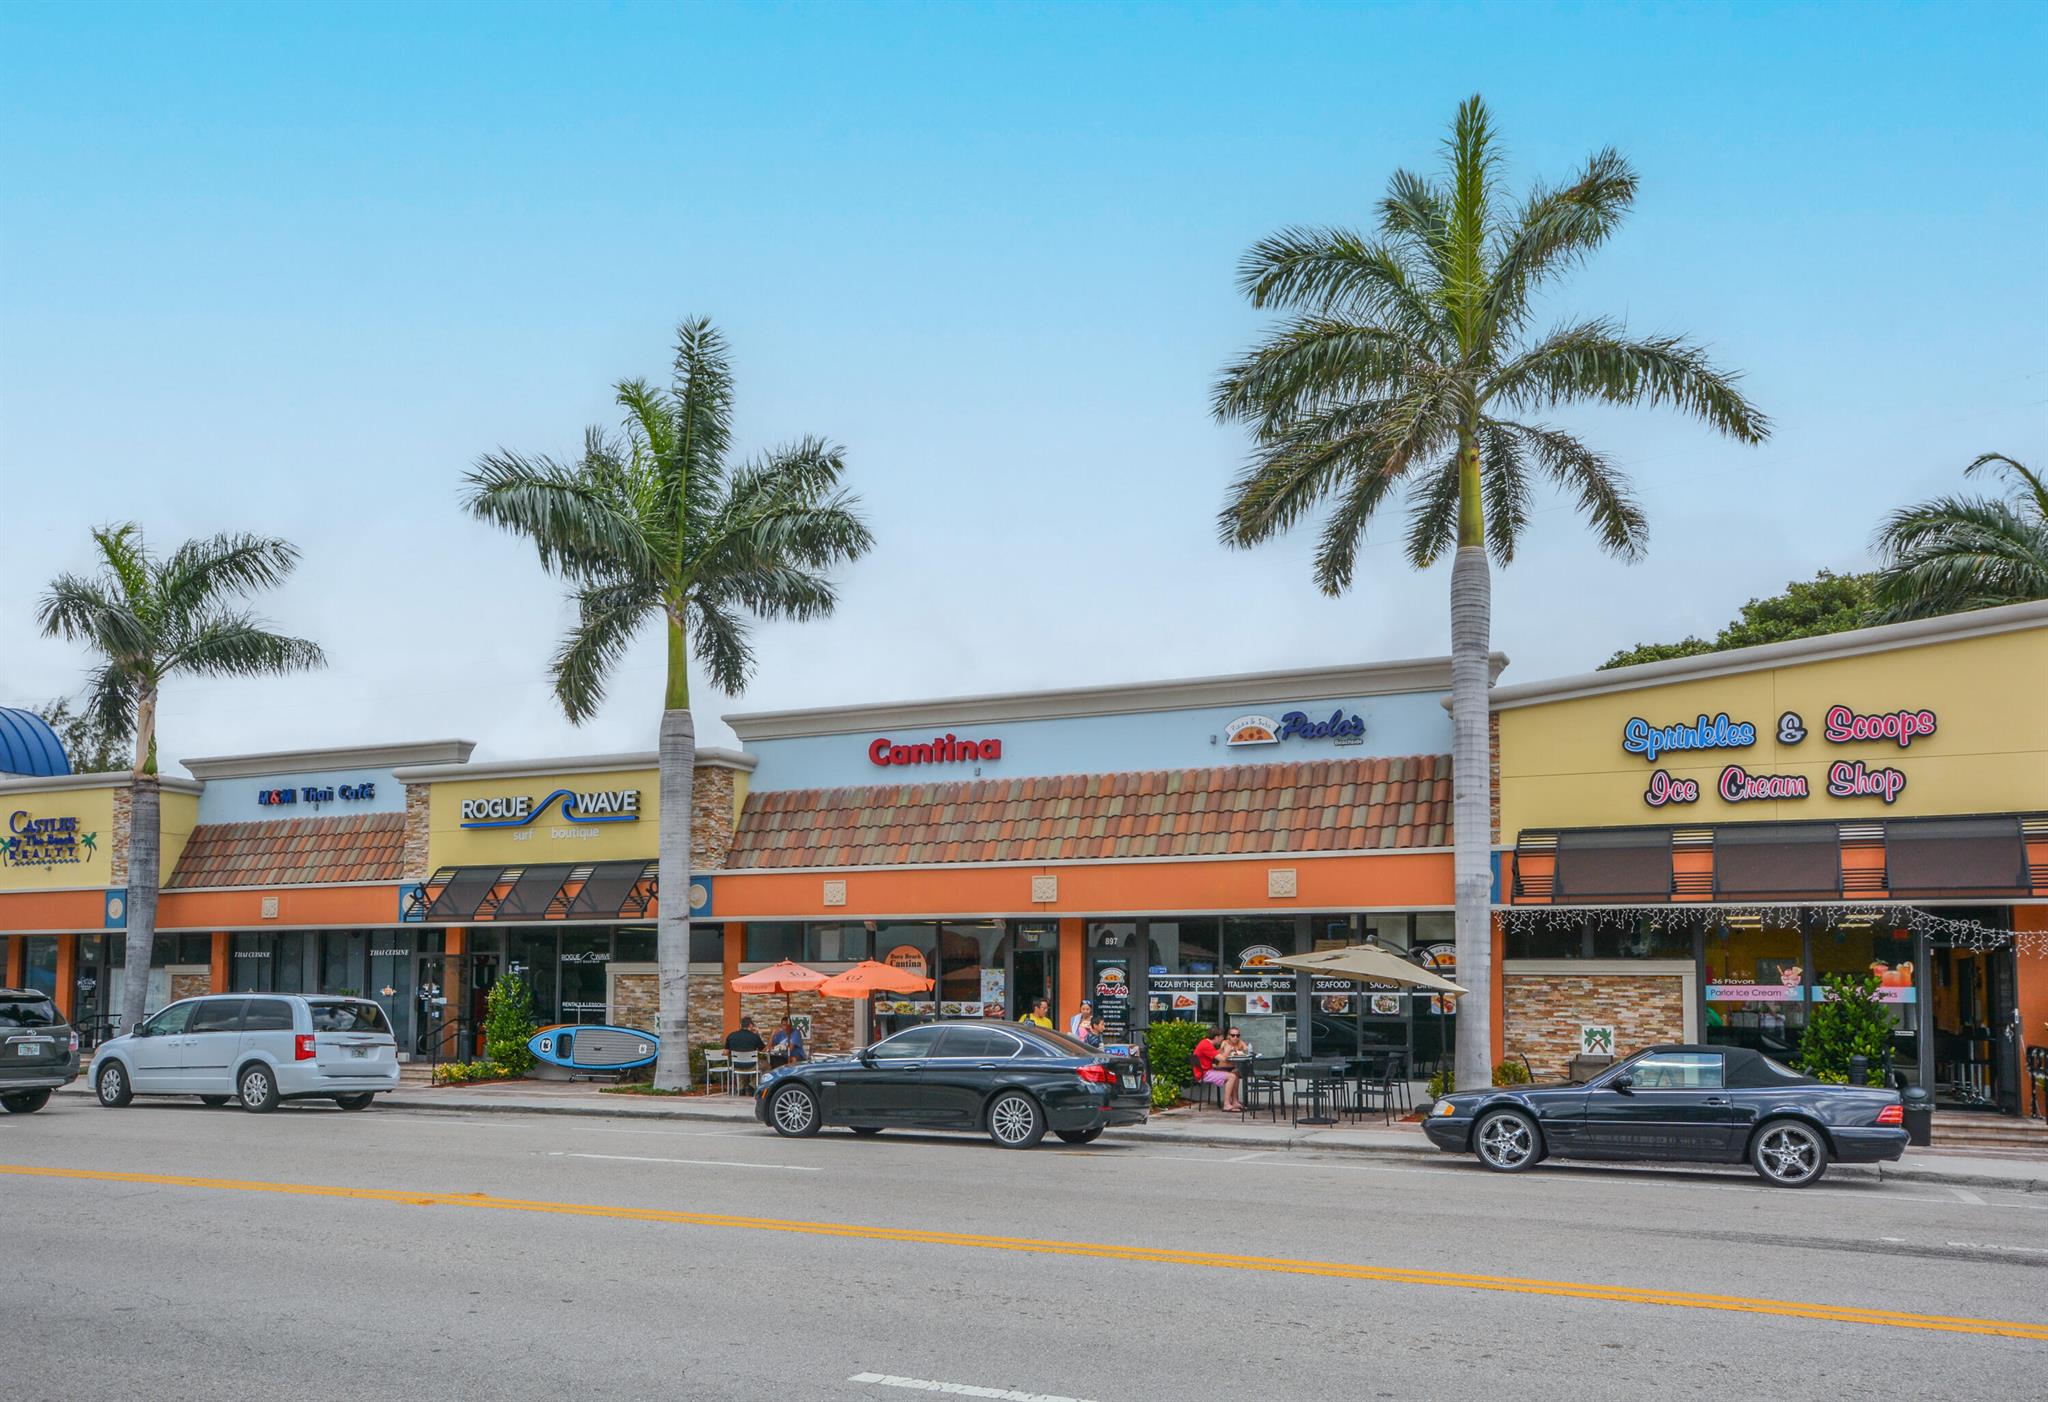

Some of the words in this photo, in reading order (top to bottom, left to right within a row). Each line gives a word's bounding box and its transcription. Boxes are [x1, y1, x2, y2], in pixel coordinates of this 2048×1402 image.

[1281, 709, 1366, 741] Paolo's
[1623, 713, 1756, 762] Sprinkles
[1777, 711, 1807, 745] &
[1825, 705, 1936, 748] Scoops
[868, 733, 1002, 767] Cantina
[1644, 769, 1700, 807] Ice
[1718, 764, 1809, 803] Cream
[1826, 760, 1906, 804] Shop
[301, 786, 335, 802] Thai
[461, 796, 533, 819] ROGUE
[575, 790, 641, 814] WAVE
[512, 828, 535, 841] surf
[551, 827, 600, 841] boutique
[9, 847, 76, 860] REALTY
[1104, 937, 1118, 946] 897
[890, 960, 922, 968] Cantina
[1154, 980, 1173, 988] PIZZA
[1174, 980, 1183, 988] BY
[1183, 980, 1196, 988] THE
[1196, 980, 1214, 988] SLICE
[1227, 981, 1253, 989] ITALIAN
[1253, 981, 1269, 989] ICES
[1272, 981, 1290, 989] SUBS
[1316, 980, 1351, 989] SEAFOOD
[1710, 988, 1734, 997] Parlor
[1736, 988, 1750, 997] Ice
[1751, 988, 1782, 997] Cream
